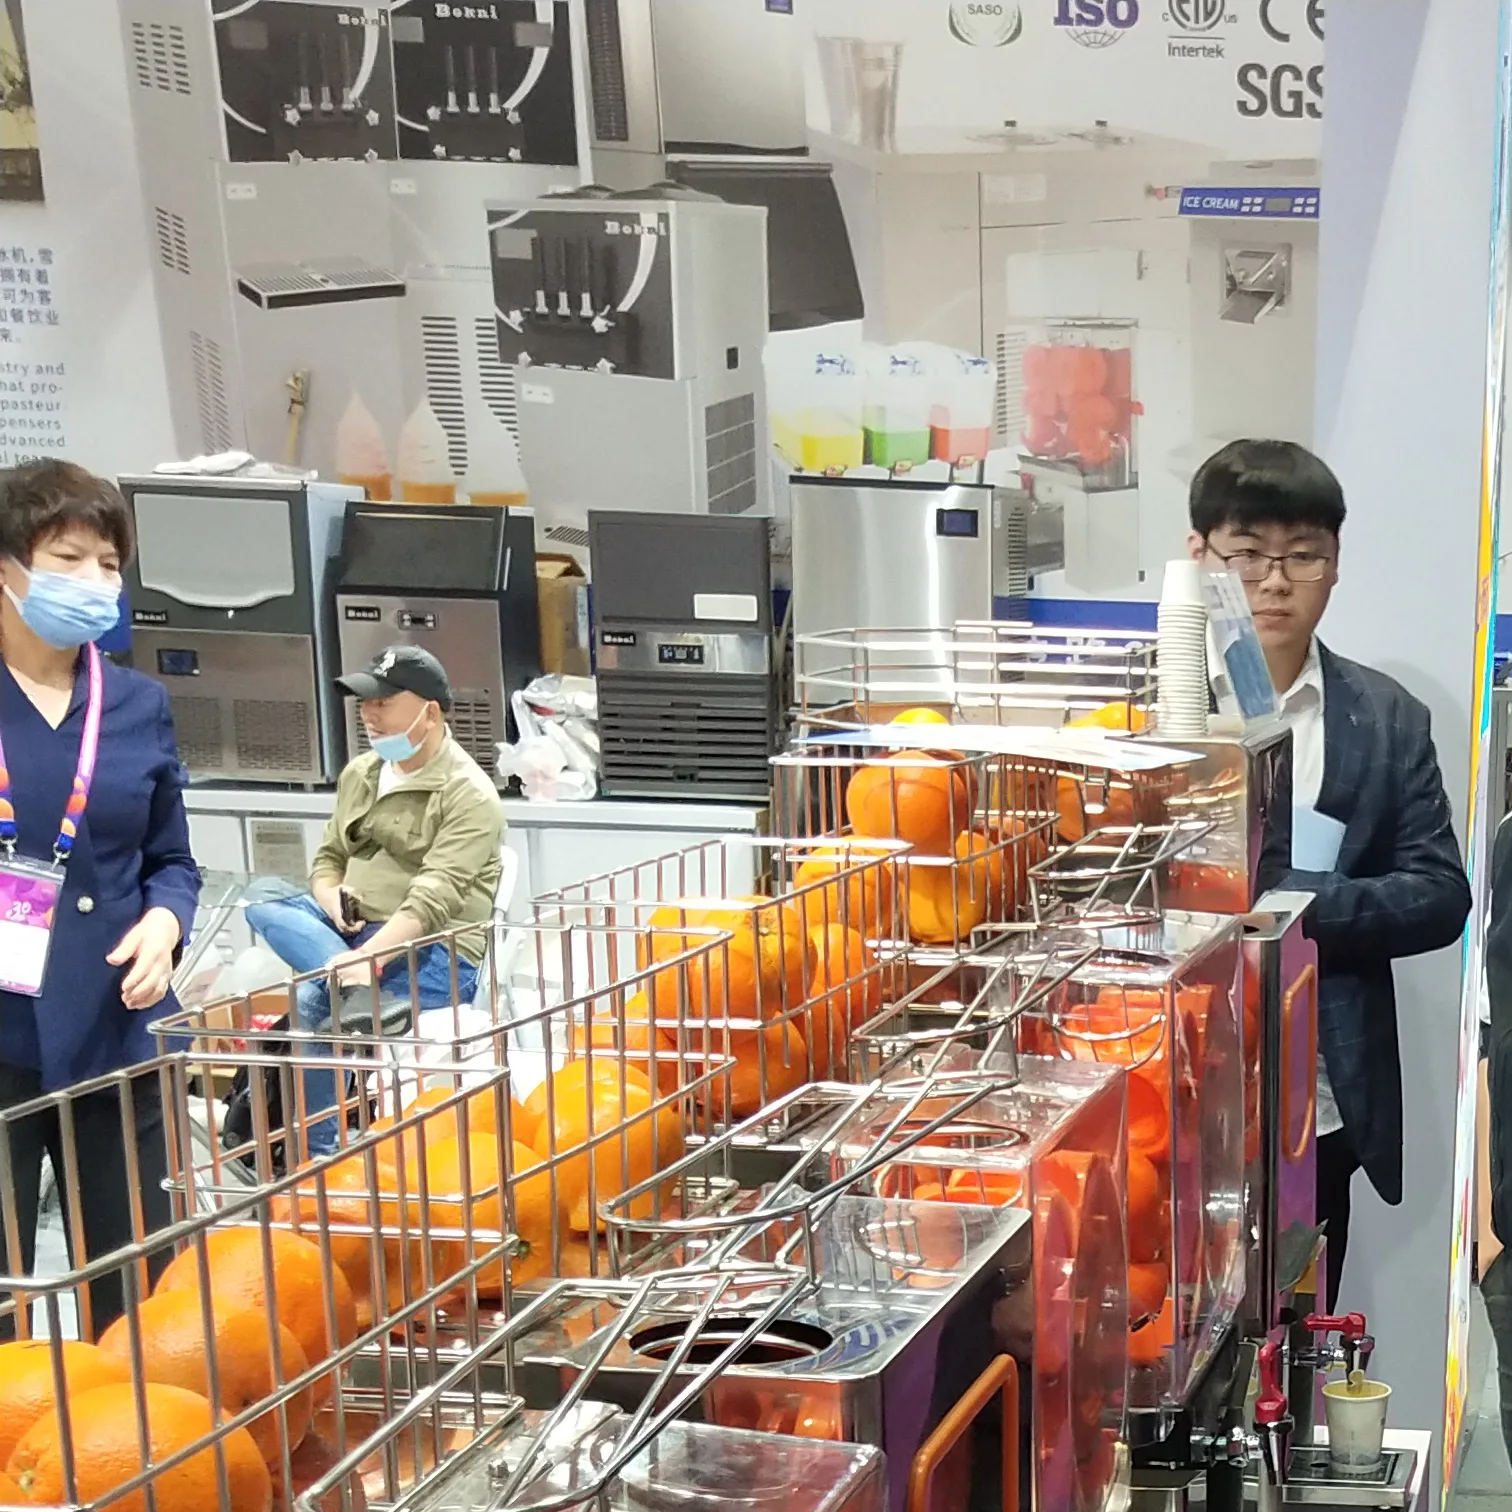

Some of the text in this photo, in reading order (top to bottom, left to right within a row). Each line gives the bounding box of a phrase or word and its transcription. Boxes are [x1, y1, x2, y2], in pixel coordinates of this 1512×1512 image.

[967, 3, 1003, 16] SASO
[1167, 42, 1225, 59] Intertek
[1182, 196, 1239, 210] ICE CREAM
[35, 362, 65, 375] and
